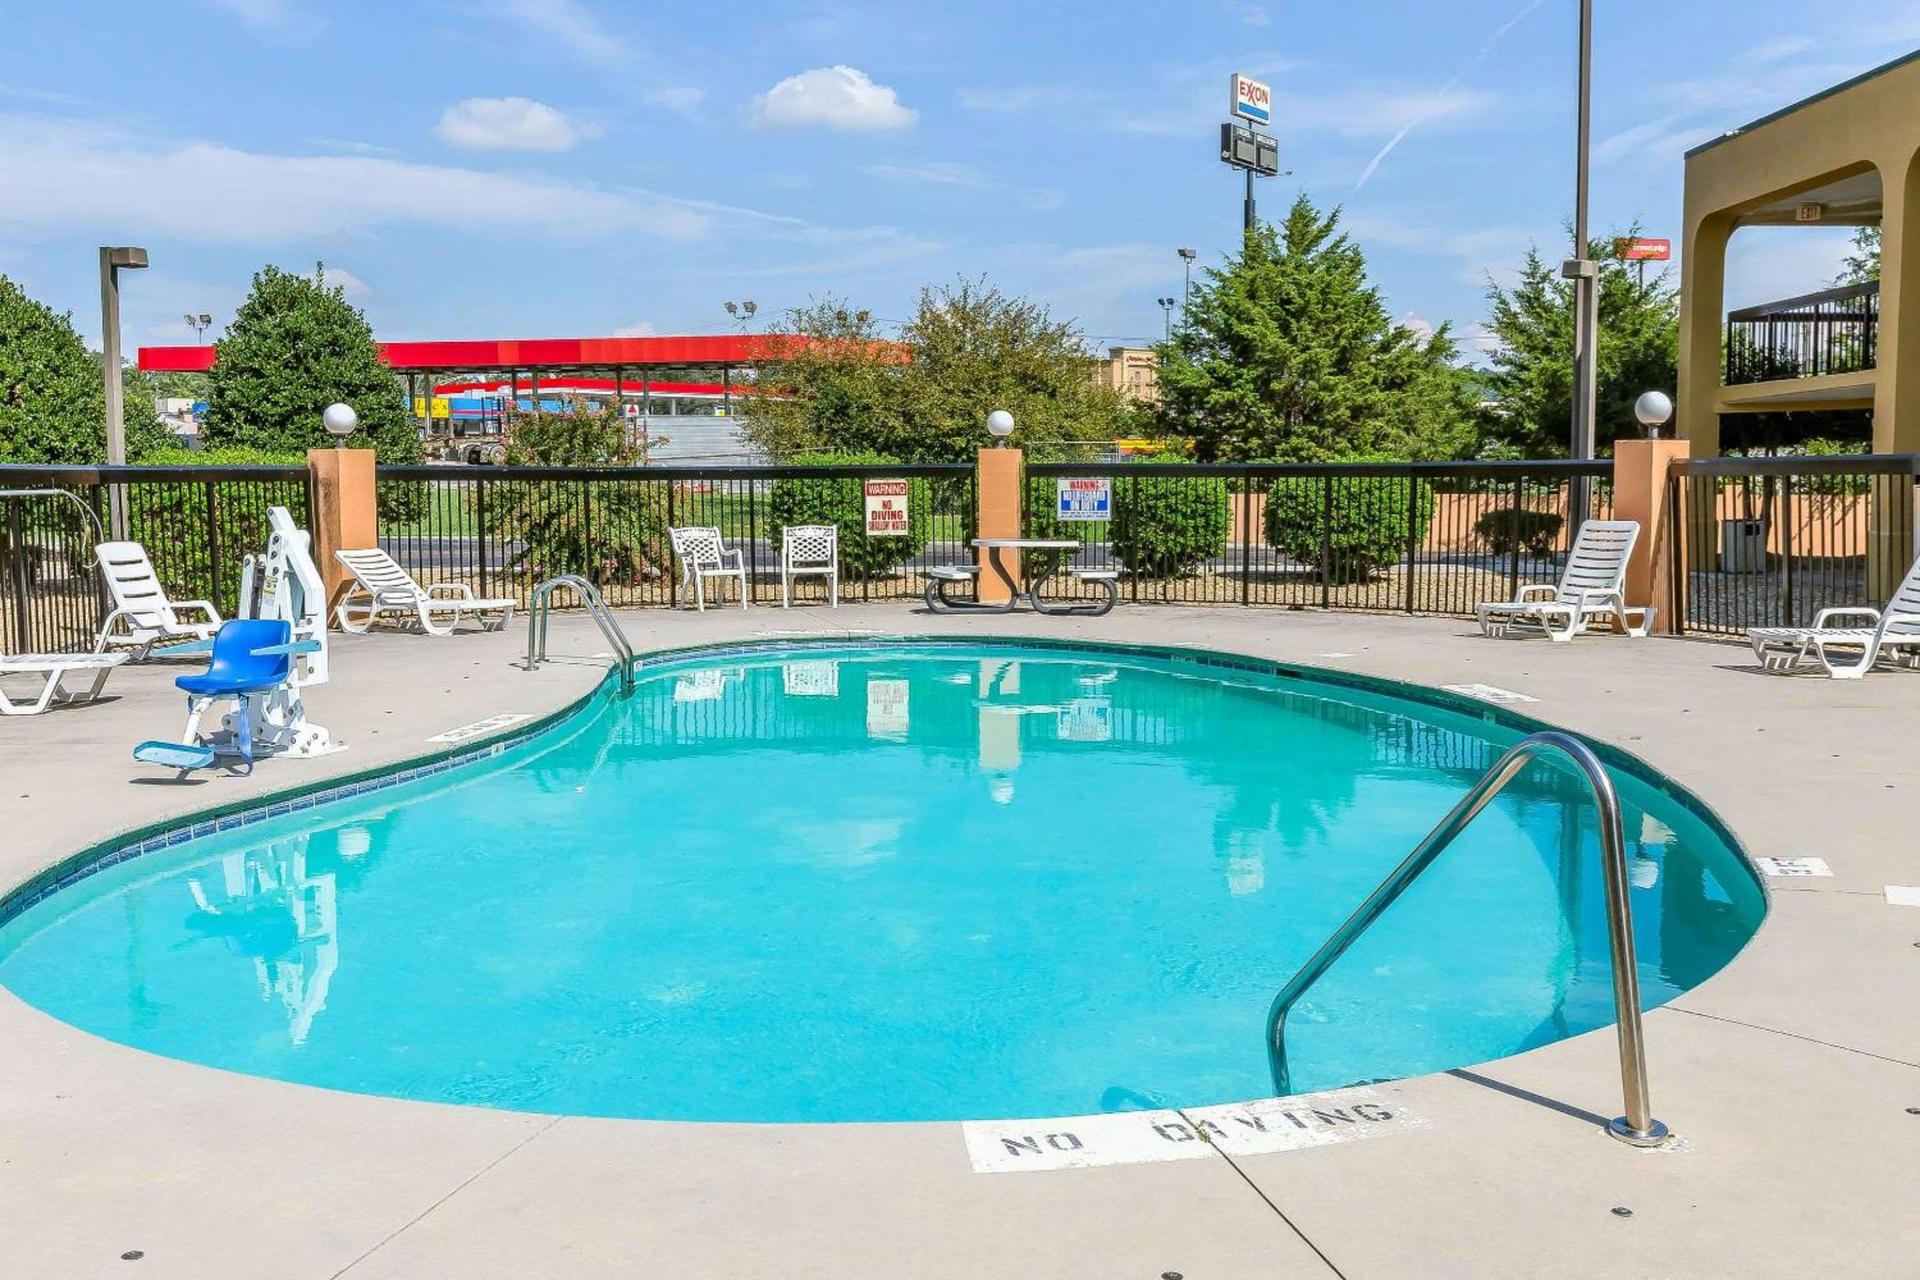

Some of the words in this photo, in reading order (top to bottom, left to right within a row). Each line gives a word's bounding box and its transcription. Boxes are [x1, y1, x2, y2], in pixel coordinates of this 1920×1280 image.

[1239, 80, 1268, 106] EXXON
[868, 483, 906, 495] WARNING
[882, 500, 892, 510] NO
[871, 510, 904, 520] DIVING
[1001, 1132, 1084, 1157] NO
